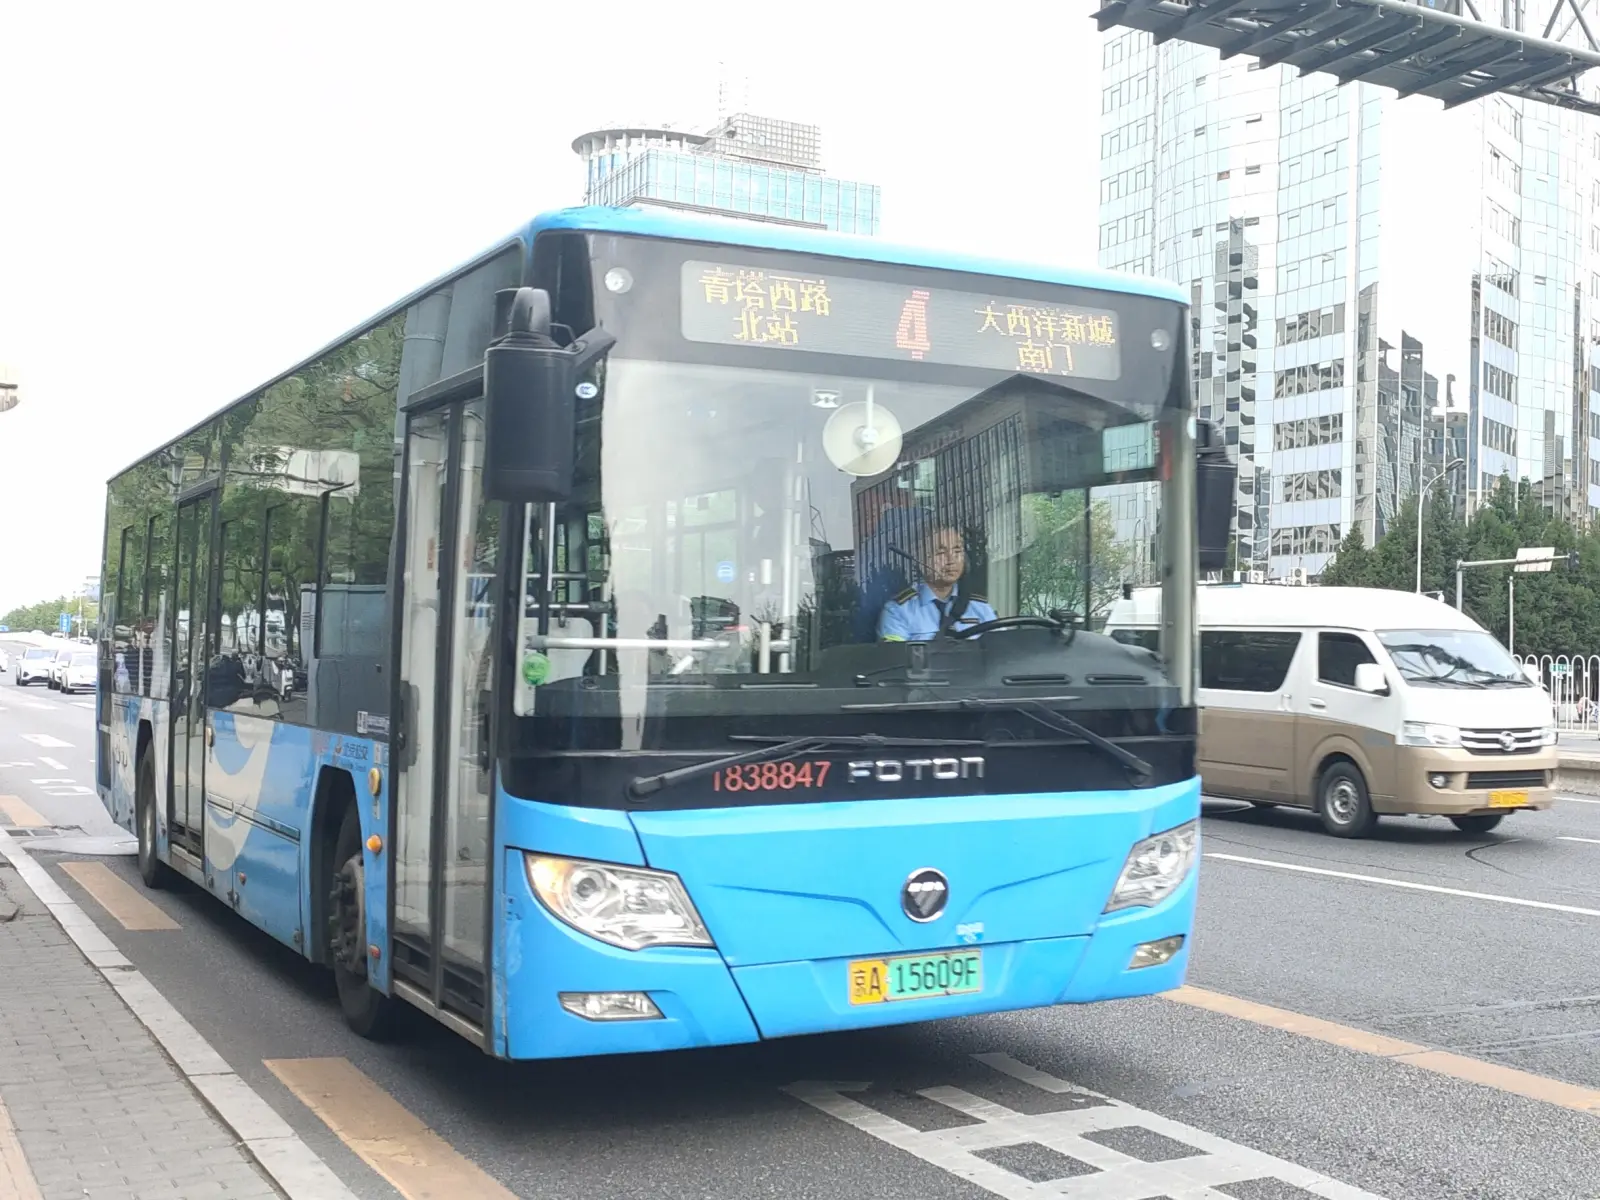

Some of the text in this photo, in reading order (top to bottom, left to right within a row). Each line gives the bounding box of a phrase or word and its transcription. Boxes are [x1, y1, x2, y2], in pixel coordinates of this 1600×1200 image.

[699, 266, 832, 317] 青塔西路
[732, 306, 800, 346] 北站
[896, 289, 931, 361] 4
[972, 300, 1117, 349] 大西洋新城
[1015, 339, 1074, 375] 南门
[713, 756, 985, 792] 1838847 FOTON
